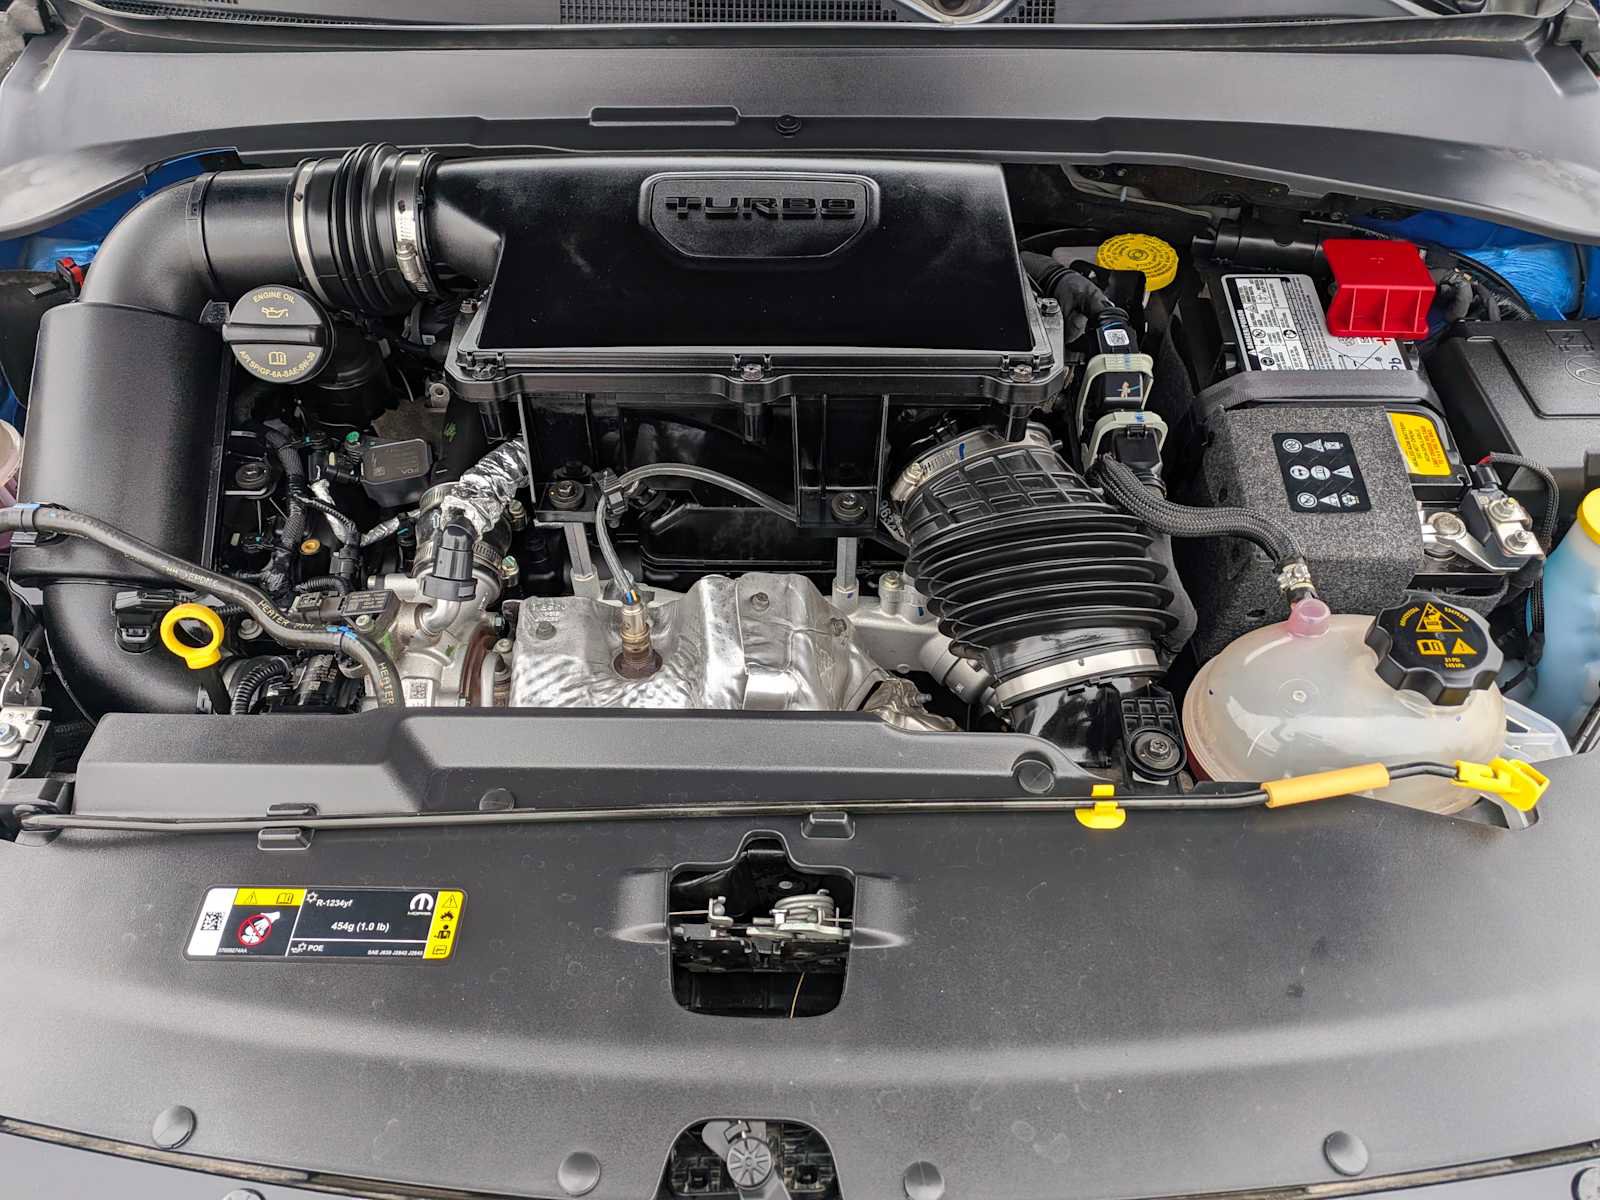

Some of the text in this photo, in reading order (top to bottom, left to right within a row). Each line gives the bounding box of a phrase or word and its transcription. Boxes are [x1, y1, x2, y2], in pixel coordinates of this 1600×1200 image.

[252, 291, 296, 305] ENGINE OIL
[257, 599, 290, 627] HEATER
[377, 661, 395, 705] HEATER
[316, 898, 353, 909] R-1234yf
[331, 921, 390, 934] 454g (1.0 lb)
[307, 944, 324, 952] POE
